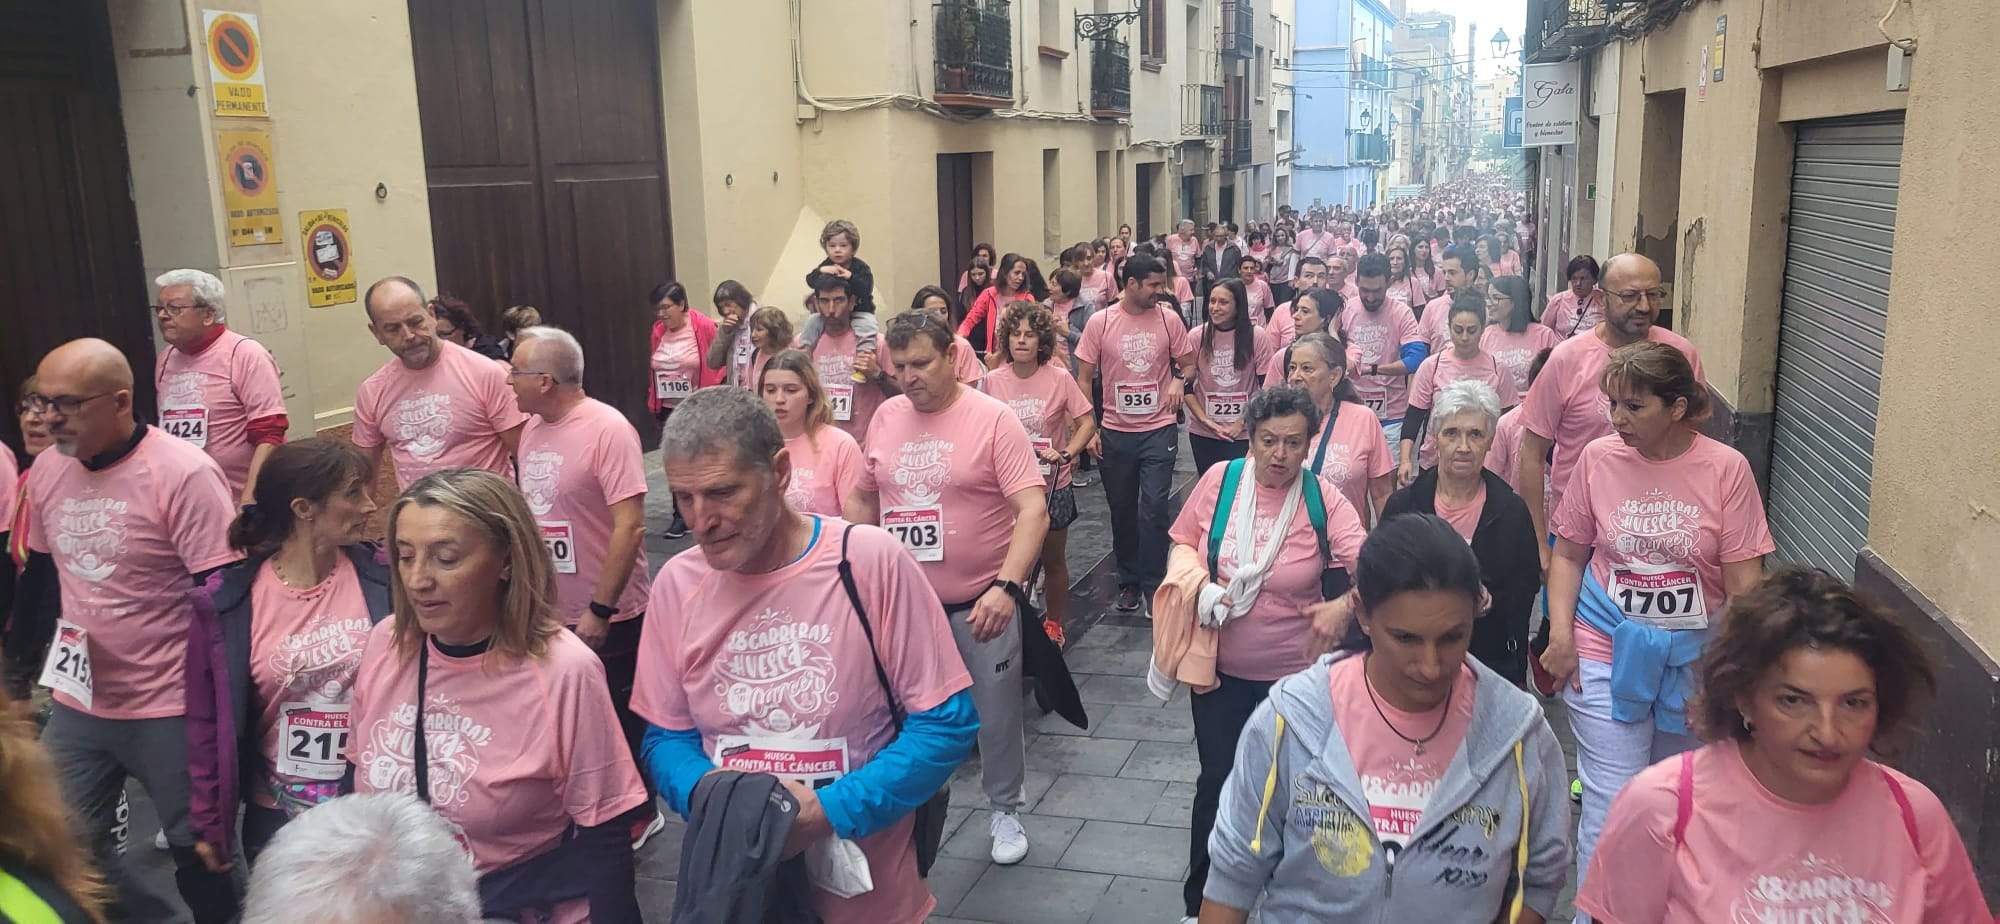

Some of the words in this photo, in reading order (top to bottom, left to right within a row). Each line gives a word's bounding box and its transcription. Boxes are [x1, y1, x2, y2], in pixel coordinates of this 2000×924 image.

[228, 87, 252, 97] VADO
[1527, 80, 1576, 109] Gala
[216, 101, 266, 113] PERMANENTE
[661, 381, 690, 392] 1106
[1124, 393, 1152, 406] 936
[1214, 403, 1241, 415] 223
[164, 420, 204, 438] 1424
[1619, 577, 1649, 589] CONTRA
[1650, 580, 1661, 588] EL
[1661, 576, 1692, 587] CÁNCER
[1641, 574, 1665, 582] HUESCA
[1618, 587, 1695, 615] 1707
[293, 716, 331, 728] CONTRA
[333, 719, 345, 728] EL
[324, 713, 350, 721] HUESC
[764, 751, 796, 761] HUESCA
[728, 758, 772, 772] CONTRA
[774, 761, 787, 773] EL
[788, 759, 838, 773] CÁNCER
[1390, 808, 1423, 823] HUESC
[1373, 817, 1401, 834] TRA
